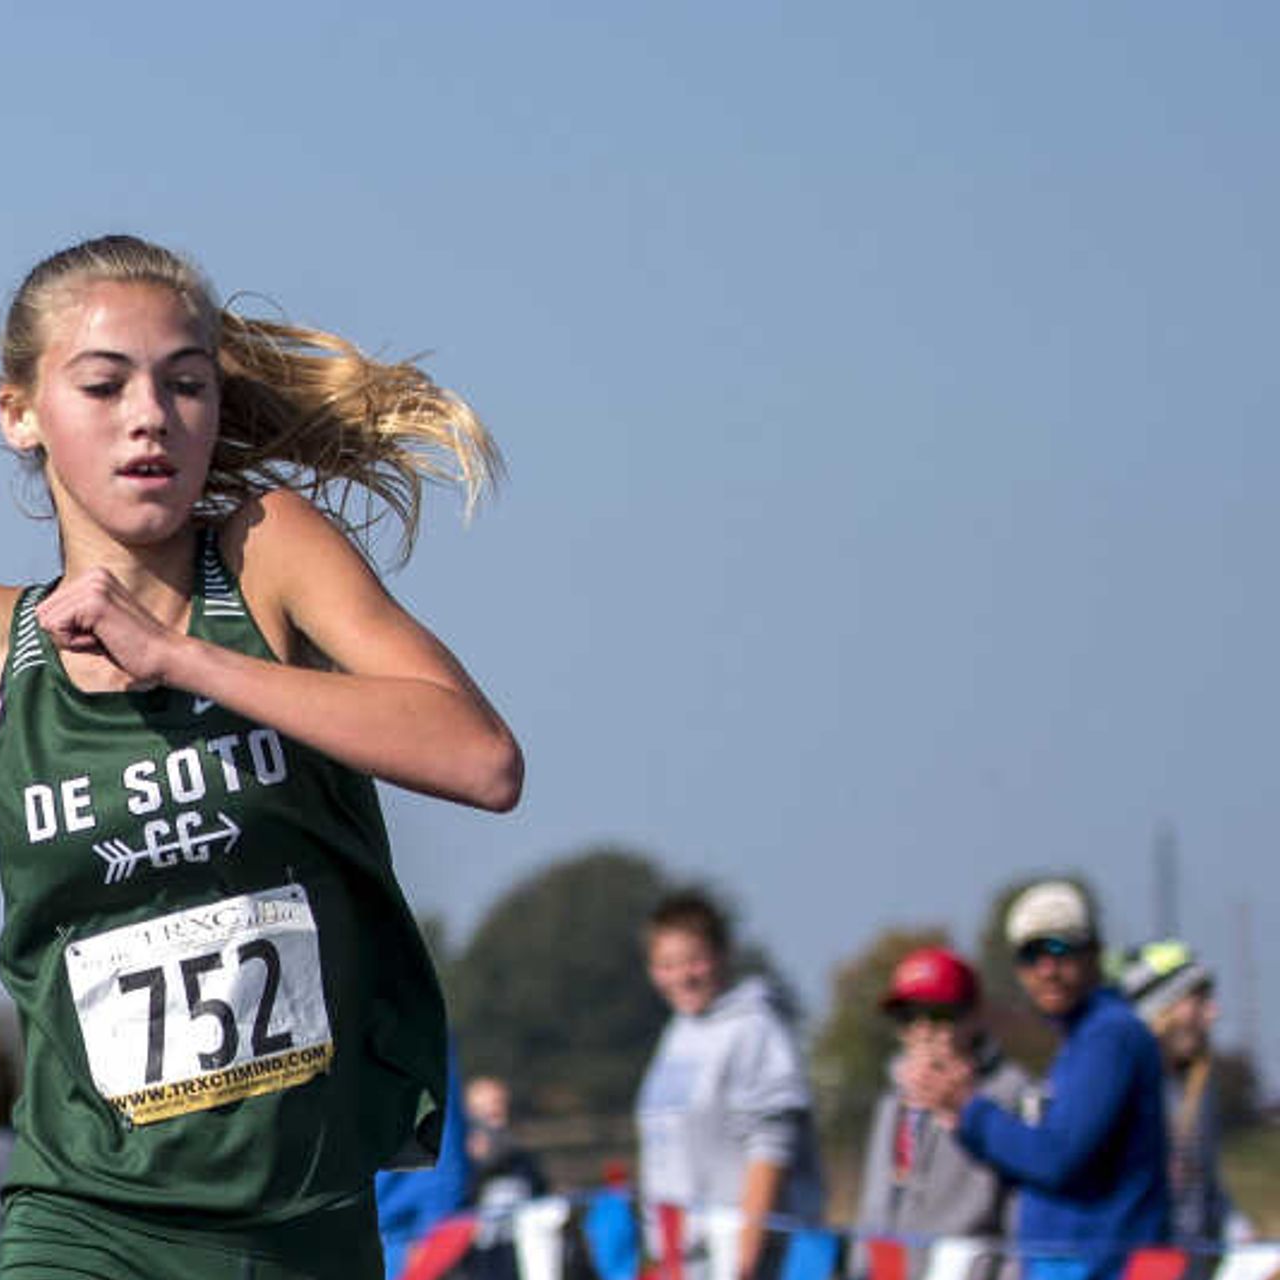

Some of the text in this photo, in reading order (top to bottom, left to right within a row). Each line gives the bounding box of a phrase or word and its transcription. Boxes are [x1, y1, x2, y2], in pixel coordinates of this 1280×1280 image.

[24, 728, 287, 844] DE SOTO
[117, 938, 295, 1085] 752
